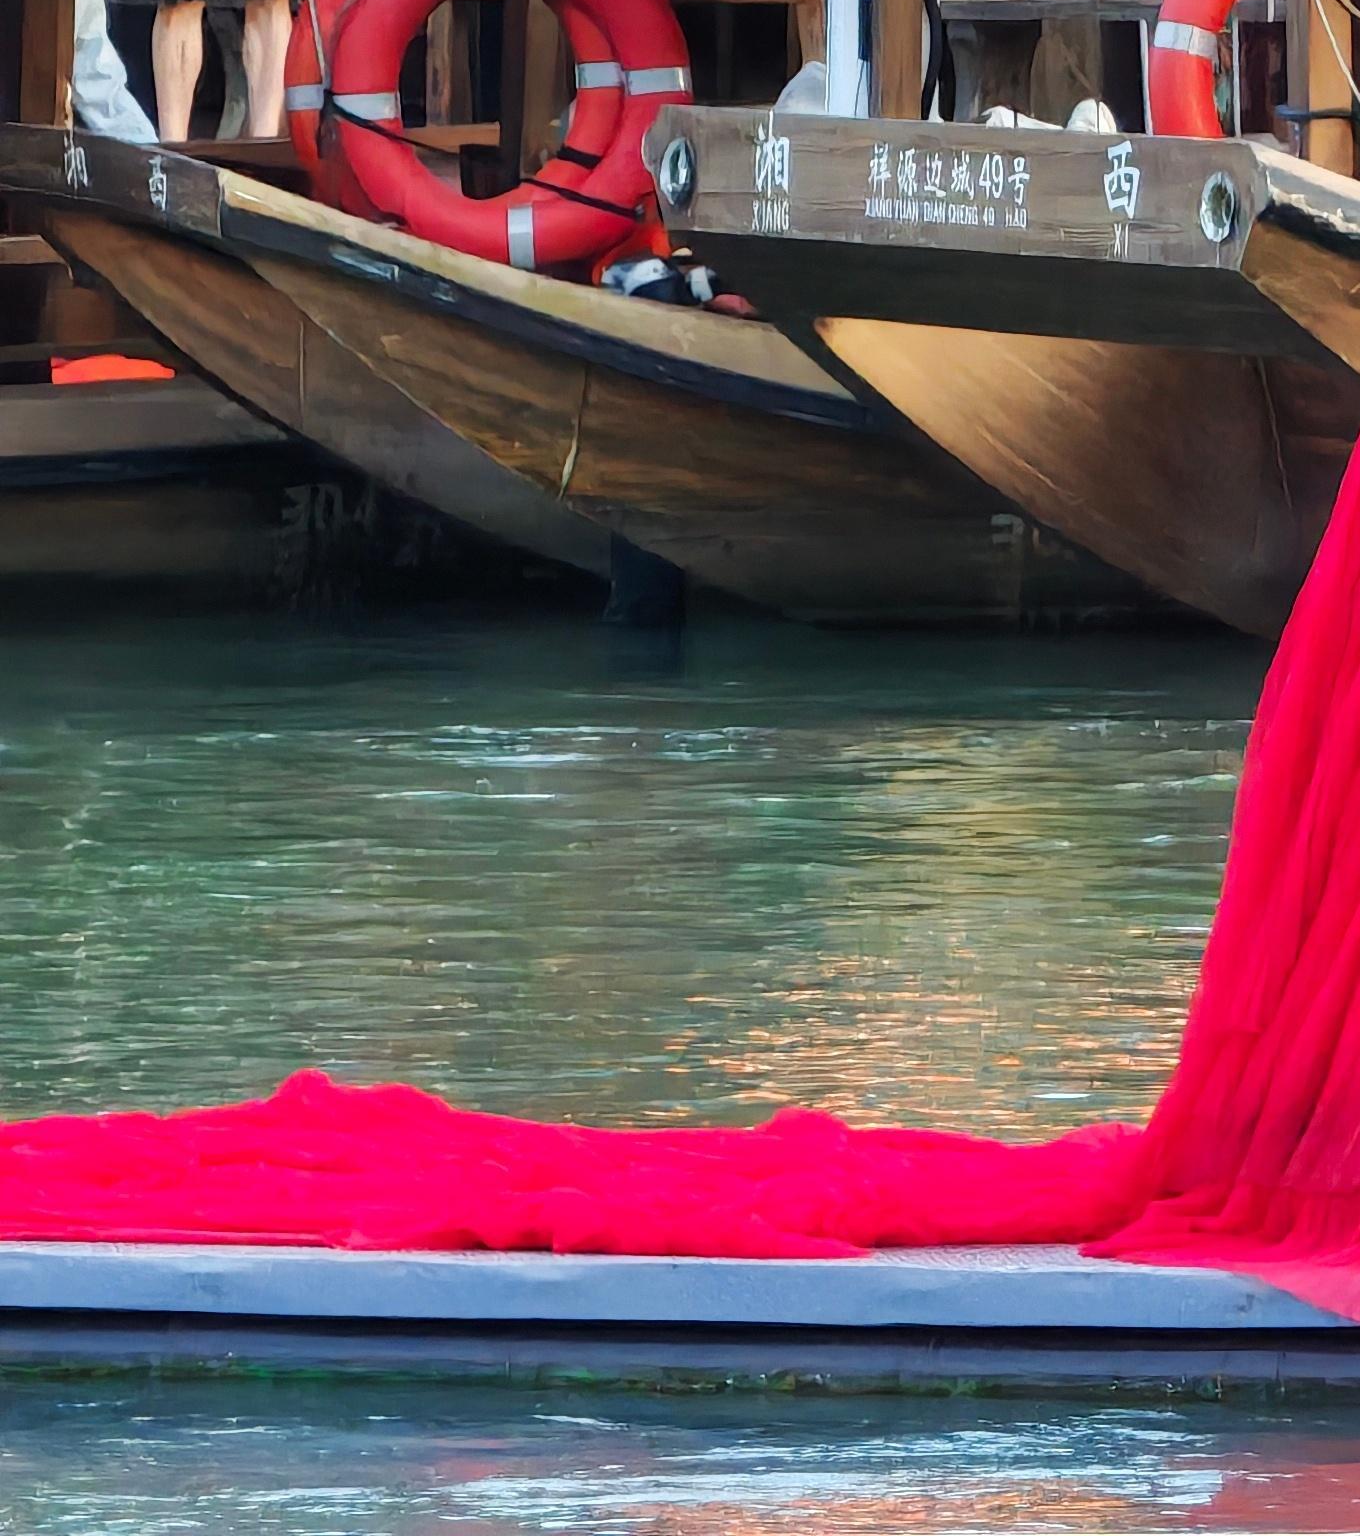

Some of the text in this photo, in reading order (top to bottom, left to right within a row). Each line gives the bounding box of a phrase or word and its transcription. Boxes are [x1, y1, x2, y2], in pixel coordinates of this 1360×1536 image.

[753, 126, 790, 198] 湘
[1103, 139, 1141, 220] 西
[751, 198, 790, 233] XIANG
[1113, 222, 1130, 259] XI
